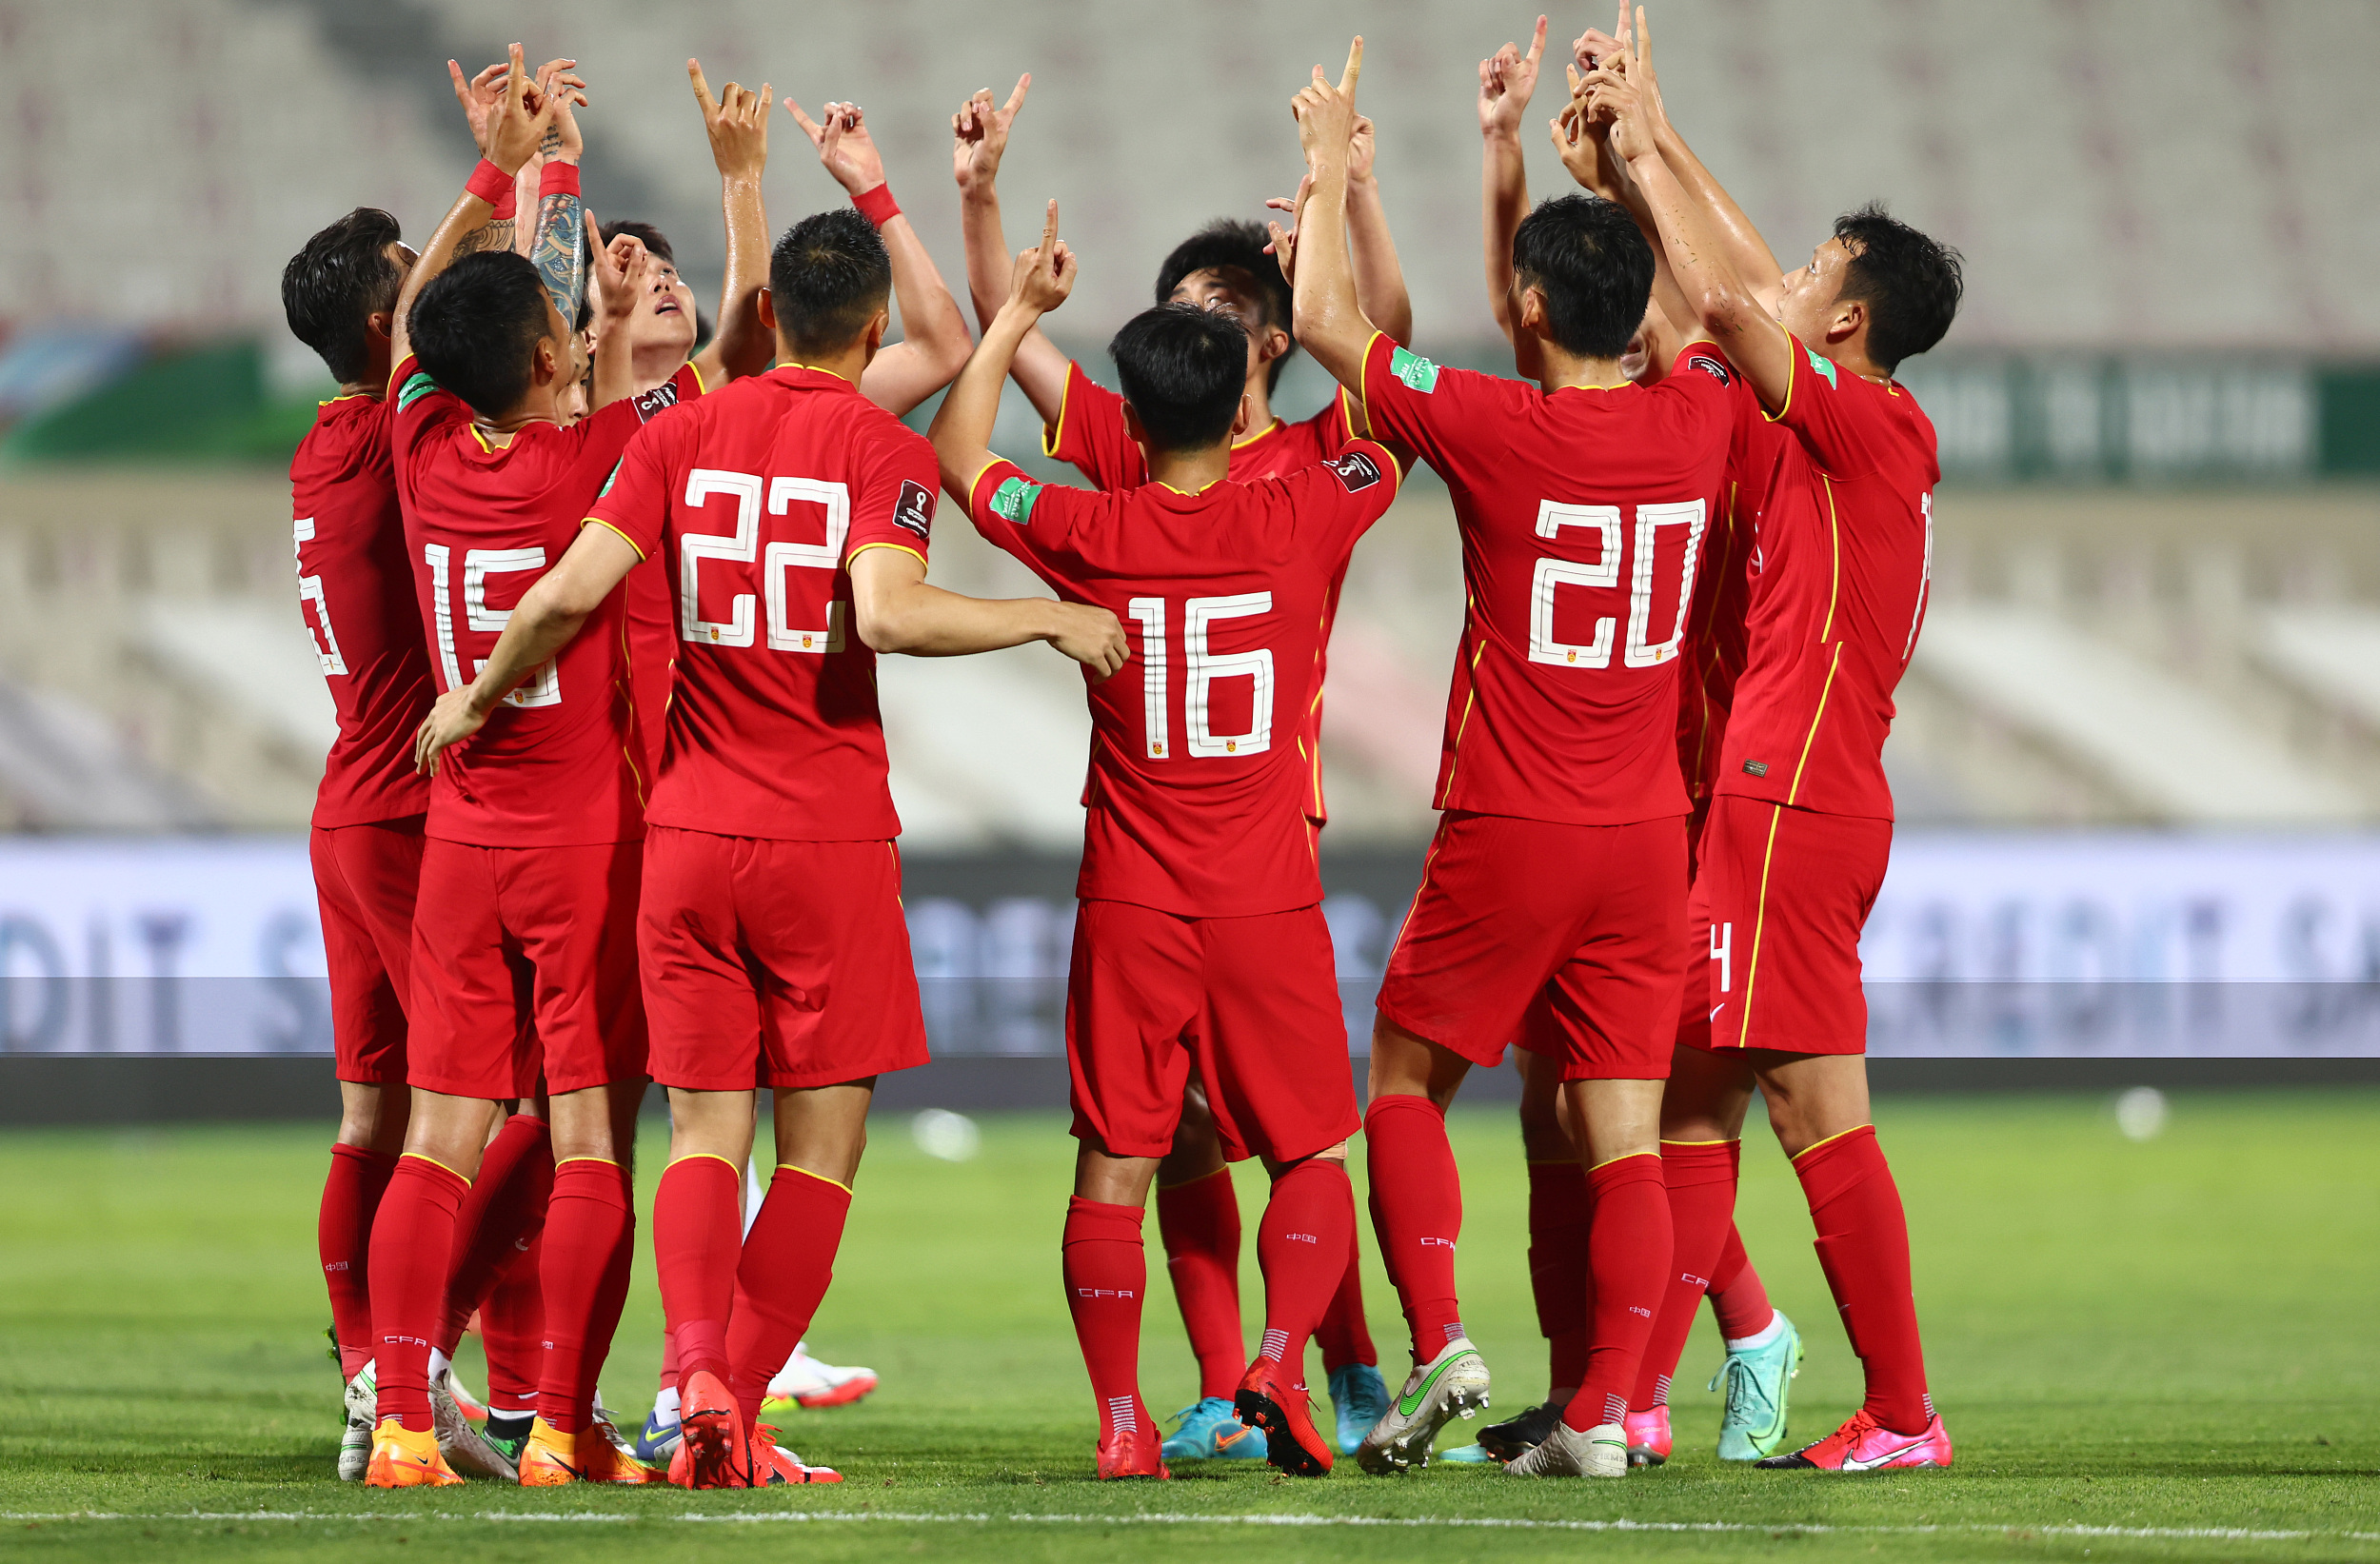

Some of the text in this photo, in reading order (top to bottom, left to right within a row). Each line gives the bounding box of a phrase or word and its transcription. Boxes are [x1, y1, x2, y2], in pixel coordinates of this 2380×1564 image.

[681, 468, 849, 654] 22
[1528, 498, 1706, 669] 20
[425, 543, 562, 708] 15
[1128, 591, 1275, 760] 16
[1710, 921, 1733, 993] 4
[1286, 1232, 1318, 1245] 中国
[1420, 1237, 1456, 1253] CFA
[325, 1260, 349, 1273] 中国
[1078, 1287, 1134, 1299] CFA
[1629, 1305, 1651, 1318] 中国
[384, 1335, 428, 1348] CFA
